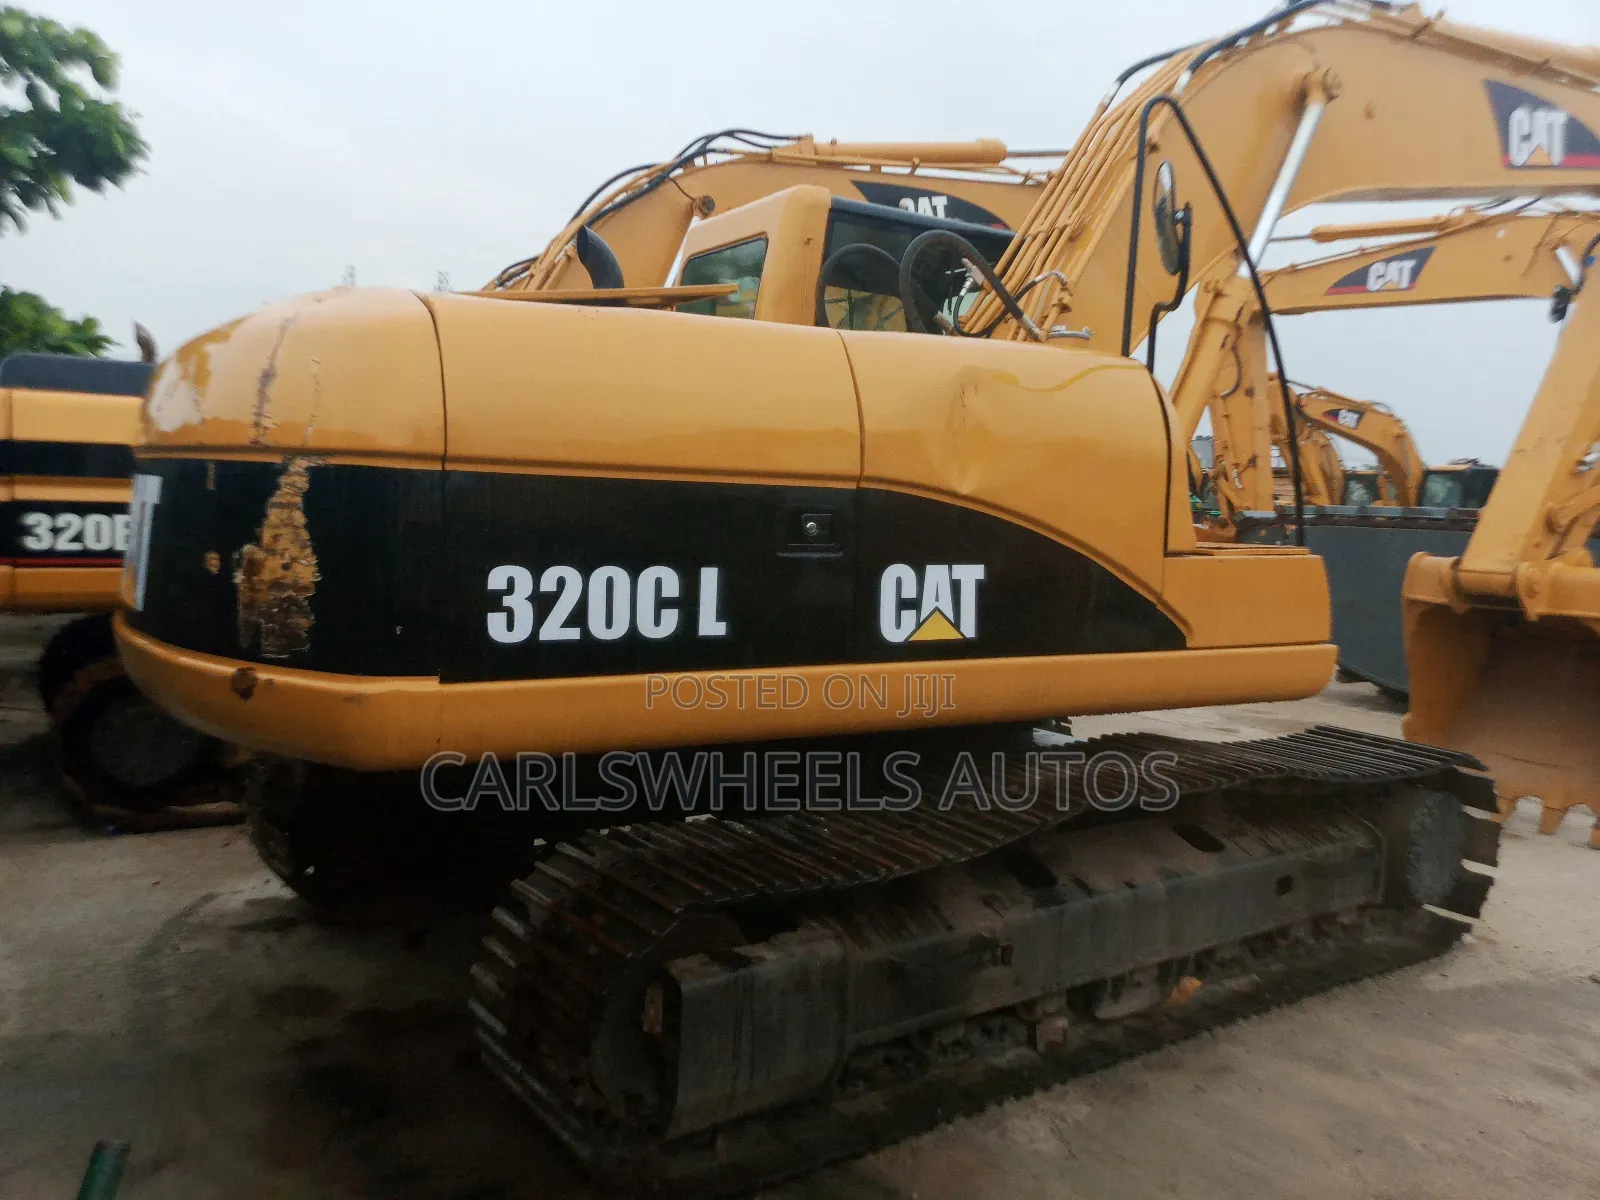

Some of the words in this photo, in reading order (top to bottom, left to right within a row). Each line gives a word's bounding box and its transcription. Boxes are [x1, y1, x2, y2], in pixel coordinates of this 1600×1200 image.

[1507, 104, 1568, 167] CAT
[1366, 259, 1417, 292] CAT
[486, 564, 680, 643] 320C
[699, 566, 727, 636] L
[879, 562, 985, 643] CAT
